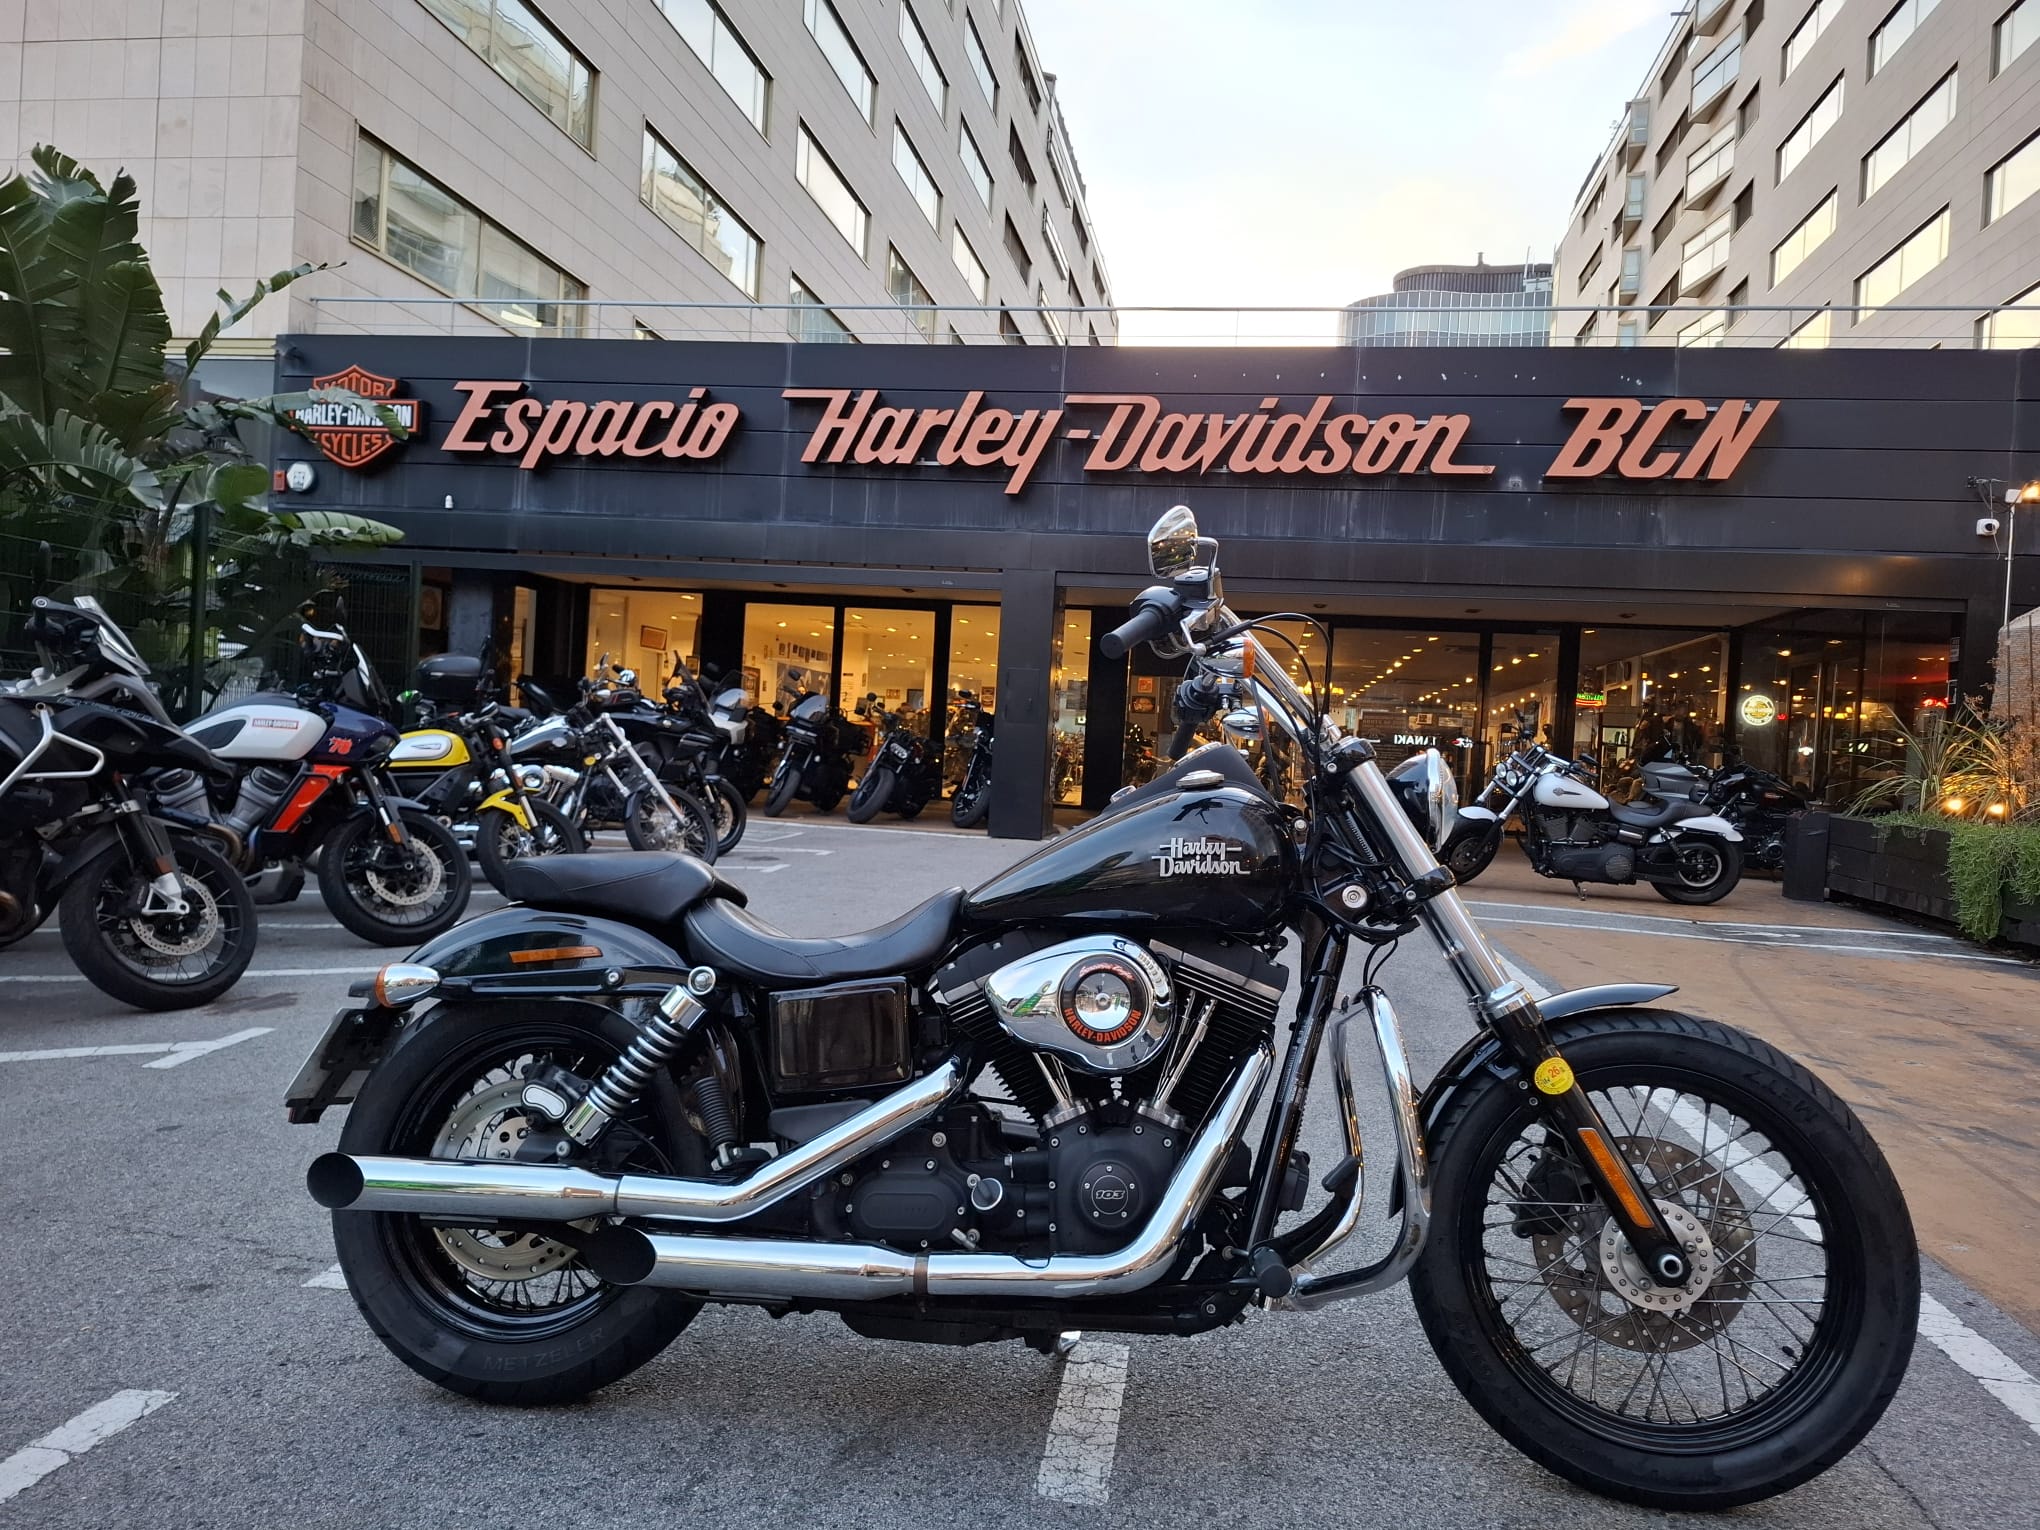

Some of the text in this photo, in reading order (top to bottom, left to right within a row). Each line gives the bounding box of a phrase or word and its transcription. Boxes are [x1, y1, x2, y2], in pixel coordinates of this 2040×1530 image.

[320, 433, 383, 461] CYCLES
[441, 381, 1781, 494] Espacio Harley-Davidson BCN
[1151, 855, 1251, 878] Davidson
[1063, 1007, 1143, 1043] HARLEY-DAVIDSON
[1095, 1190, 1126, 1200] 103
[482, 1327, 605, 1372] METZELER
